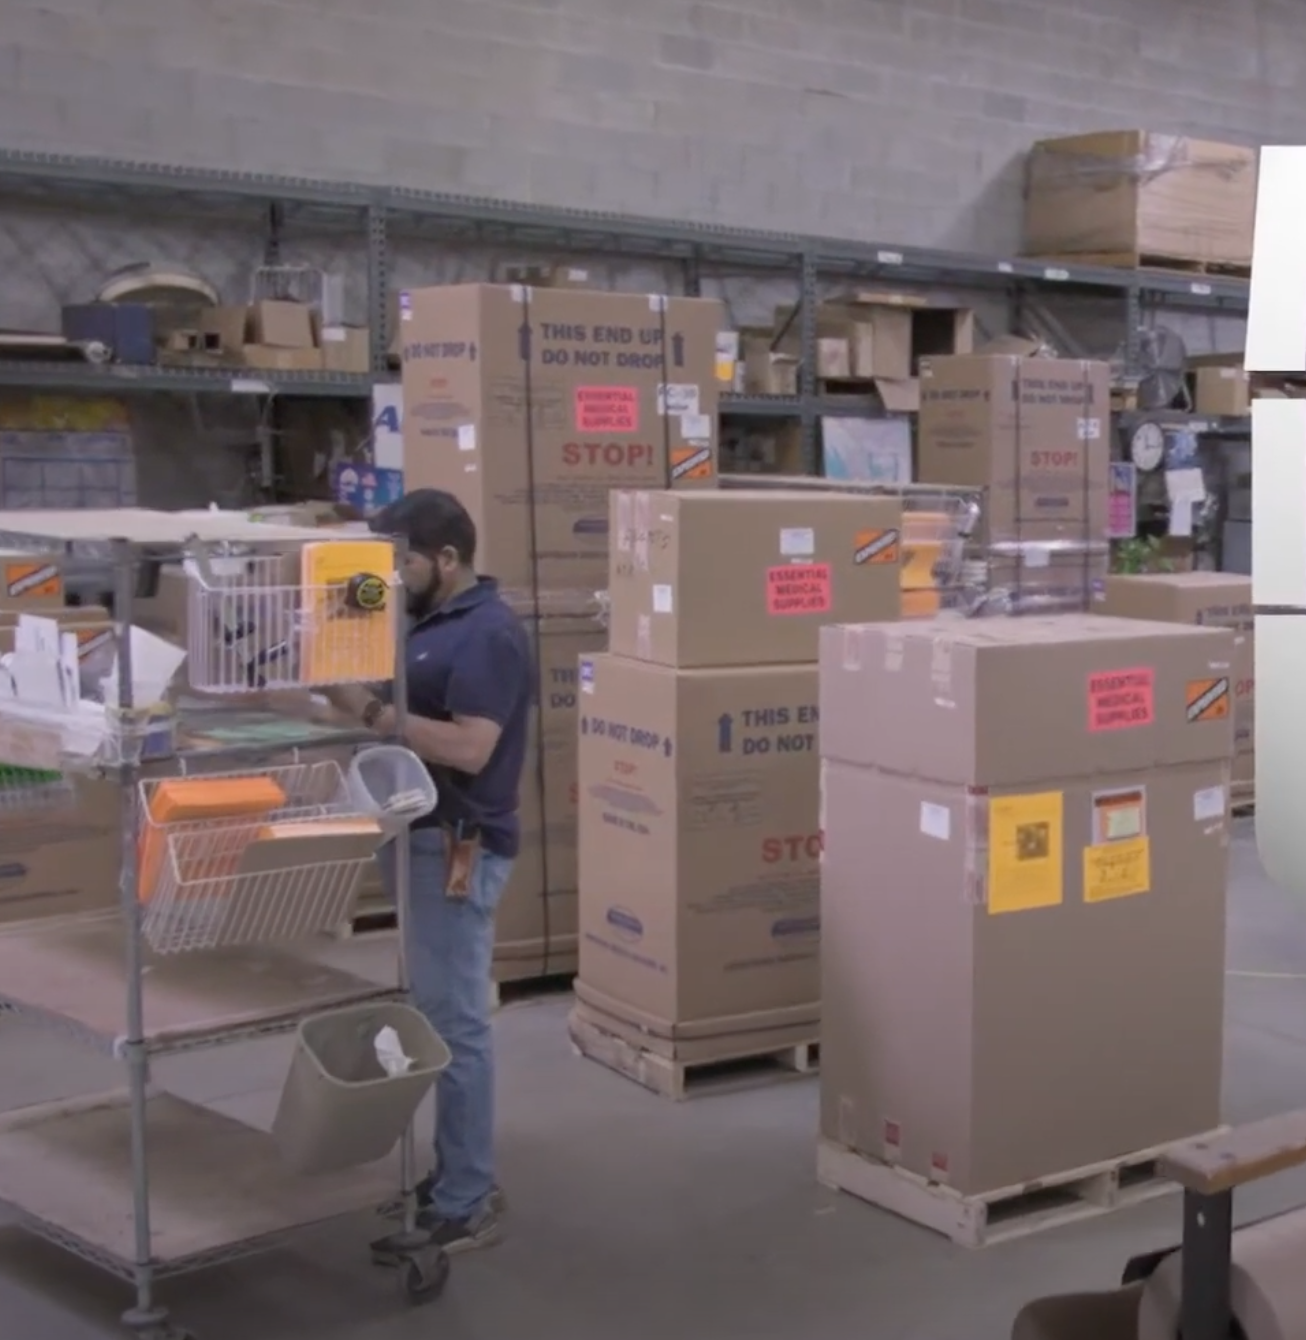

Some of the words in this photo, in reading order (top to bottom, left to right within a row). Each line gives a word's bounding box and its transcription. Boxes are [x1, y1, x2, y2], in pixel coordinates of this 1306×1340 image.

[540, 322, 586, 342] THIS
[593, 325, 632, 344] END
[639, 328, 664, 345] UP
[542, 348, 568, 366] DO
[573, 350, 611, 367] NOT
[616, 352, 664, 369] DROP
[562, 442, 653, 466] STOP!
[1030, 450, 1078, 467] STOP!
[769, 568, 828, 583] ESSENTIAL
[741, 707, 790, 728] THIS
[592, 717, 605, 735] DO
[608, 721, 628, 742] NOT
[630, 726, 659, 749] DROP
[742, 736, 770, 756] DO
[777, 733, 814, 753] NOT
